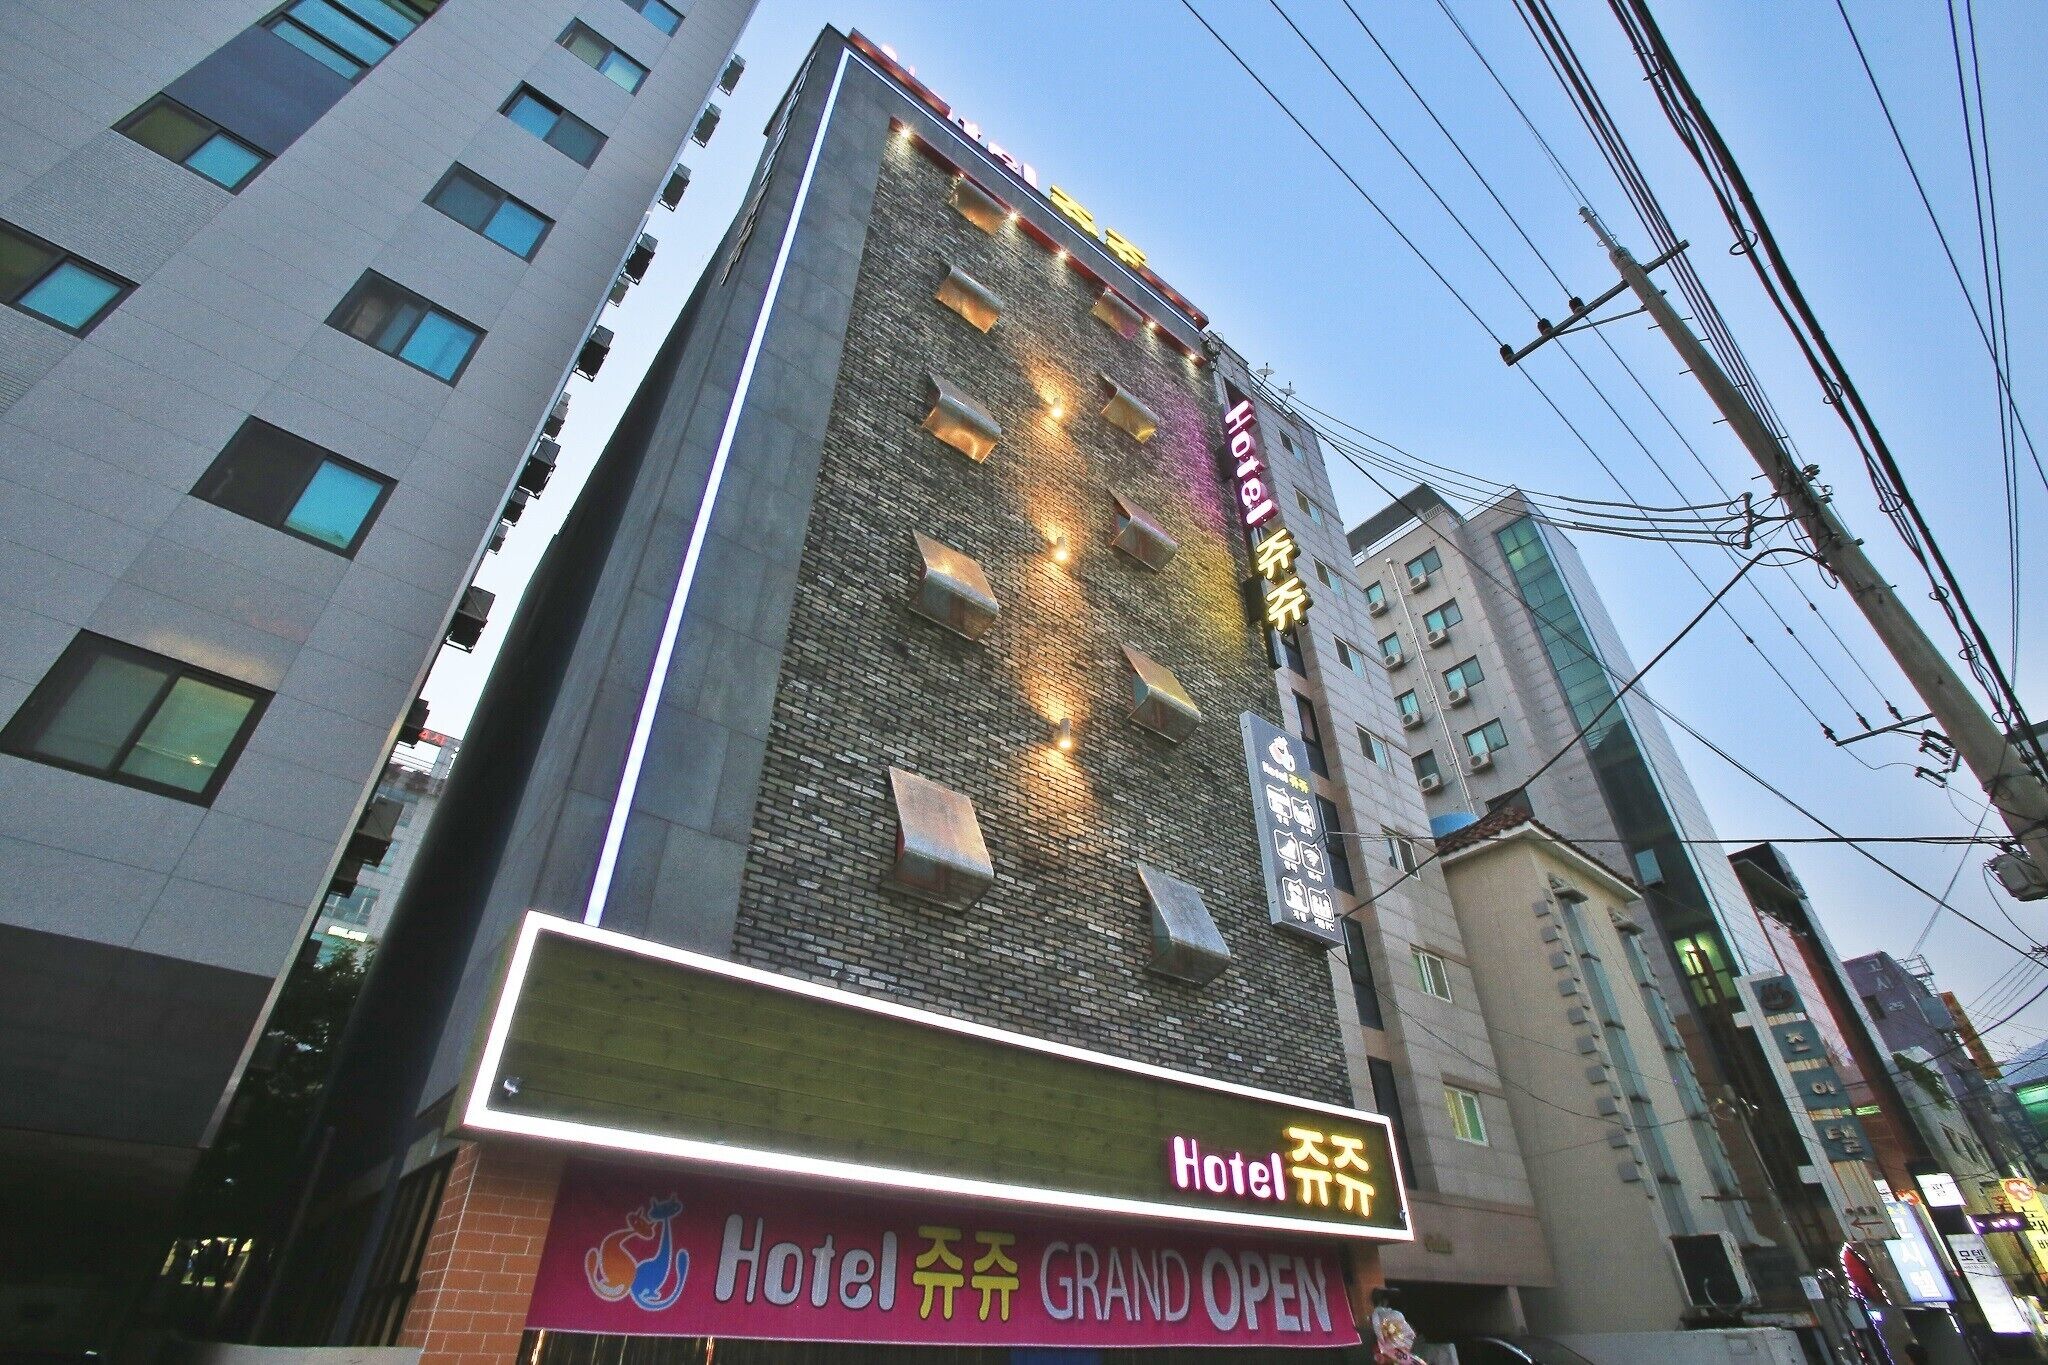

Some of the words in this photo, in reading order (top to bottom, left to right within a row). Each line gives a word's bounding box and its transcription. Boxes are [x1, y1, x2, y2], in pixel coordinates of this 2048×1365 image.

[1225, 400, 1273, 524] Hotel
[1257, 528, 1306, 631] 쥬쥬
[1173, 1136, 1286, 1201] Hotel
[1288, 1126, 1375, 1217] 쥬쥬
[714, 1213, 898, 1311] Hotel
[912, 1225, 1020, 1321] 쥬쥬
[1040, 1241, 1191, 1322] GRAND
[1202, 1248, 1333, 1332] OPEN
[1958, 1249, 1988, 1263] 모텔
